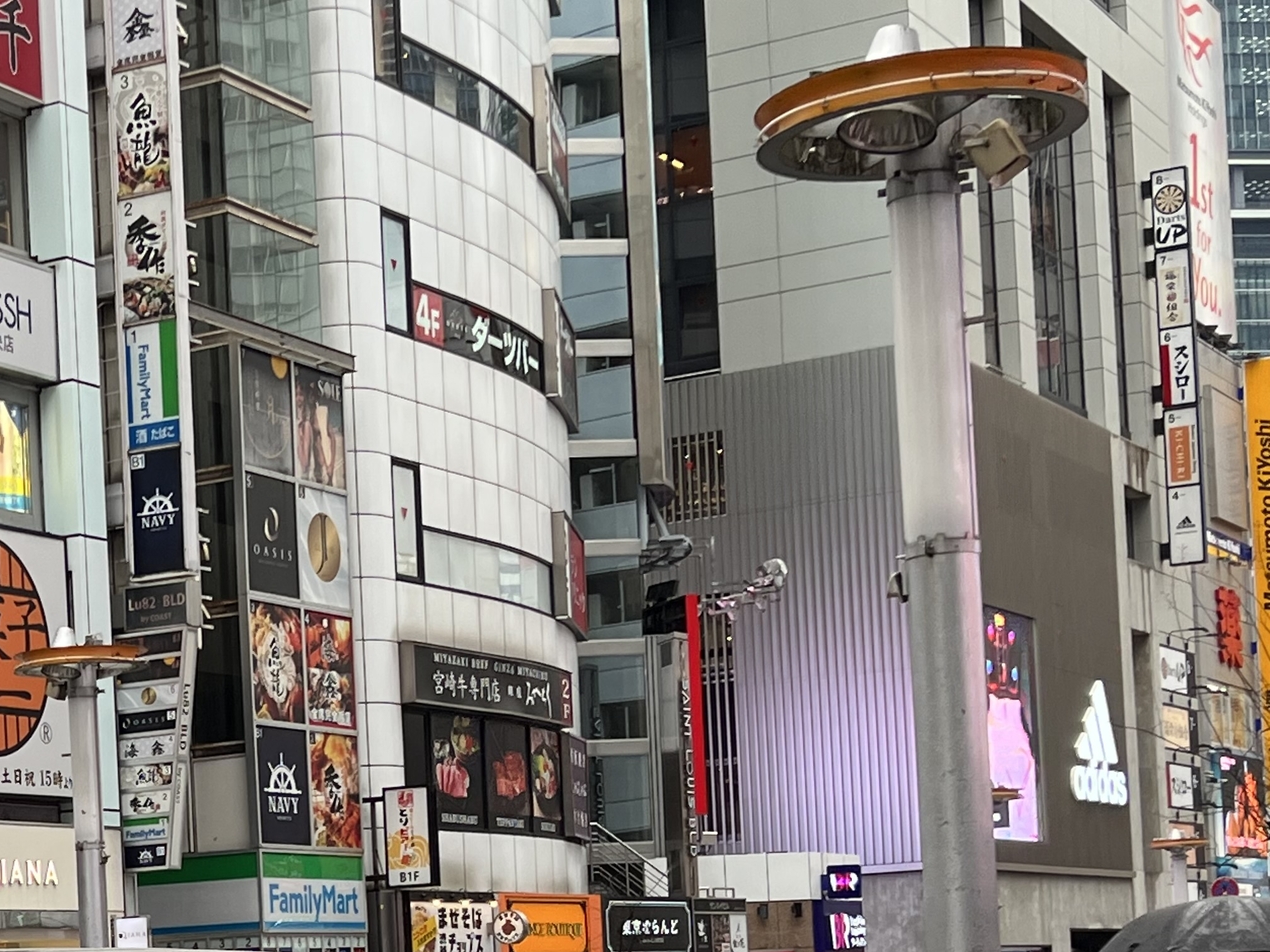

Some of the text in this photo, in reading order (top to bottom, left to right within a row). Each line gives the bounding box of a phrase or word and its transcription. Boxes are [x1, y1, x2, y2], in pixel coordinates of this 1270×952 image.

[120, 75, 129, 89] 3
[124, 203, 133, 217] 2
[1156, 224, 1188, 244] UP
[415, 293, 440, 338] 4F
[471, 315, 539, 375] ダーツバー
[1173, 344, 1190, 401] スシロー
[136, 343, 152, 420] FamilyMart
[151, 426, 176, 440] たばこ
[132, 456, 144, 469] B1
[141, 513, 176, 530] NAVY
[253, 544, 293, 561] OASIS
[128, 592, 185, 611] Lu82 BLD
[132, 716, 166, 726] OASIS
[268, 795, 299, 814] NAVY
[125, 828, 166, 840] FamilyMart
[400, 871, 420, 882] B1F
[268, 883, 359, 922] FamilyMart
[246, 936, 252, 947] 2
